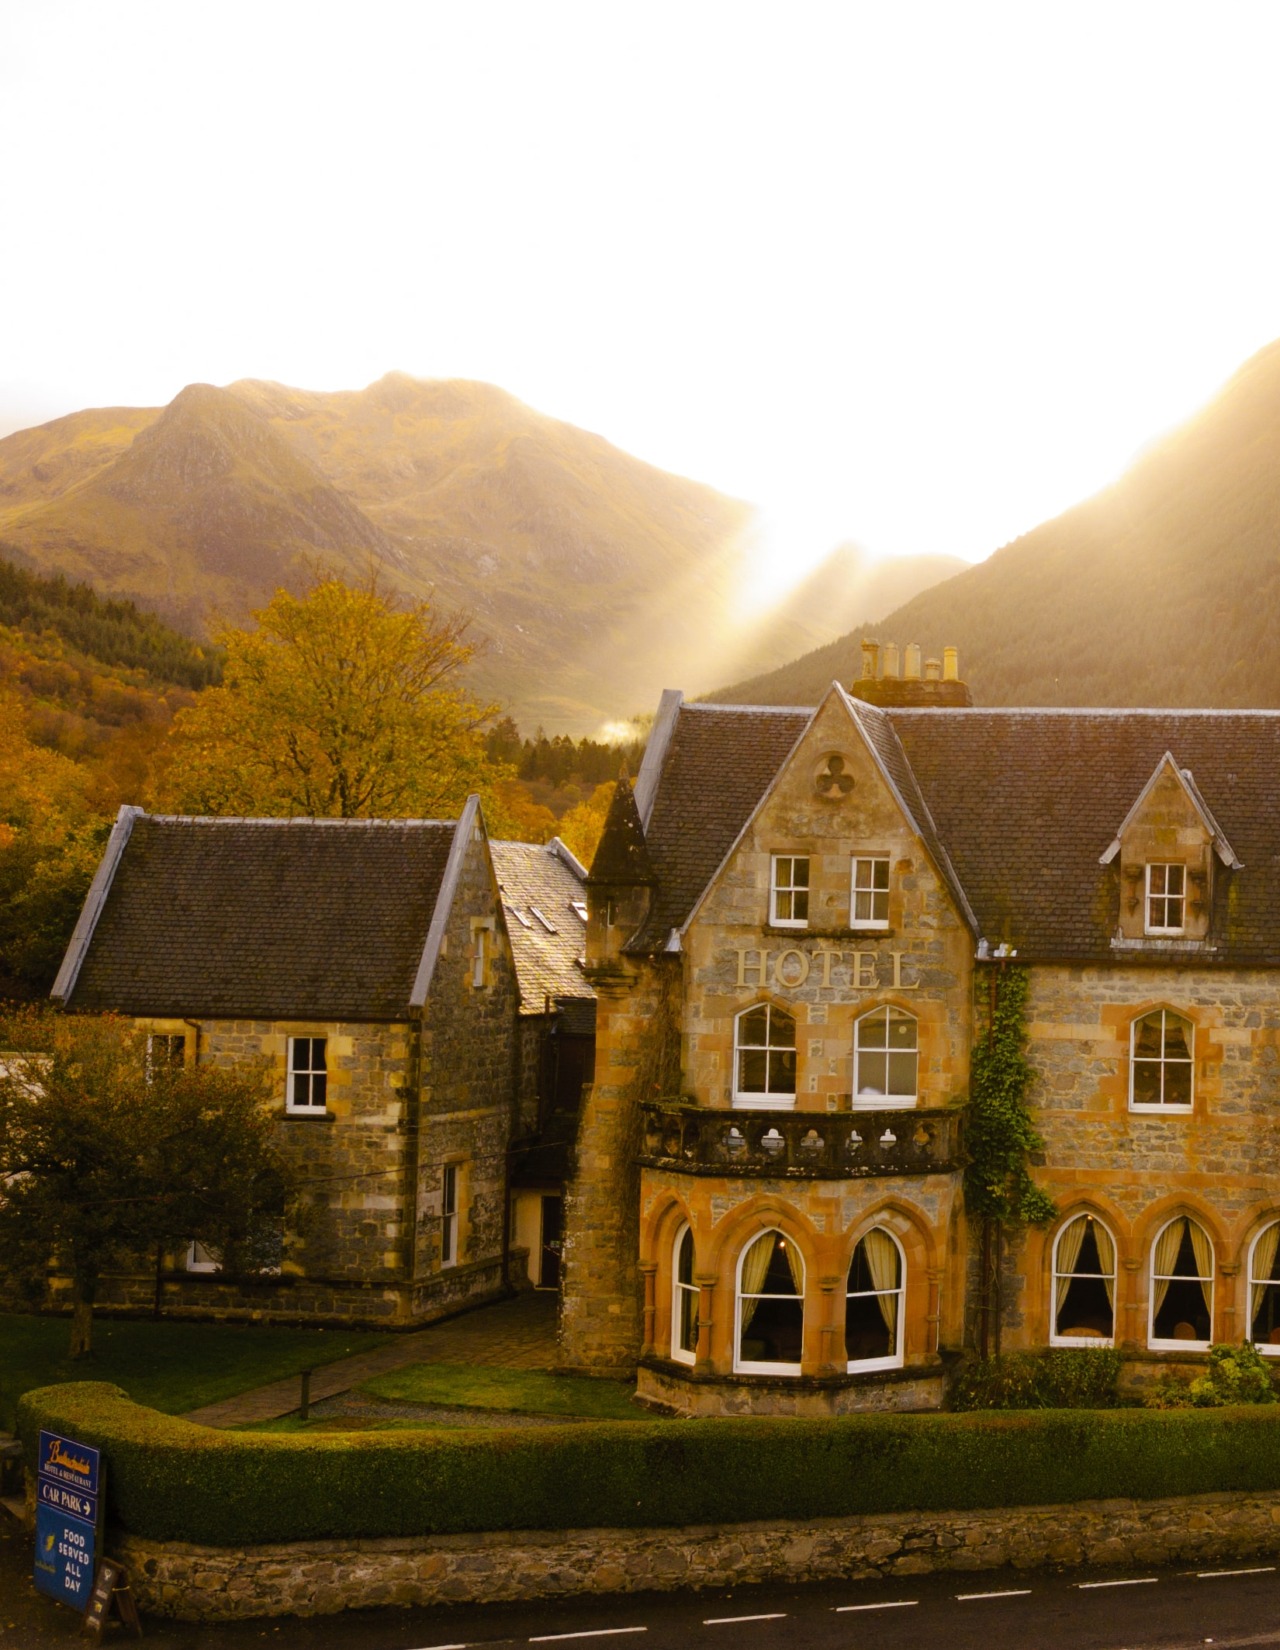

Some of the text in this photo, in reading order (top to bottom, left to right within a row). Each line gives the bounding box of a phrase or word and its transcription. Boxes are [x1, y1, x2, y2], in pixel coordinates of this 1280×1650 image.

[733, 949, 921, 990] HOTEL
[42, 1484, 82, 1513] CAR PARK
[63, 1528, 85, 1548] FOOD
[58, 1542, 90, 1565] SERVED
[64, 1562, 82, 1578] ALL
[64, 1575, 81, 1593] DAY
